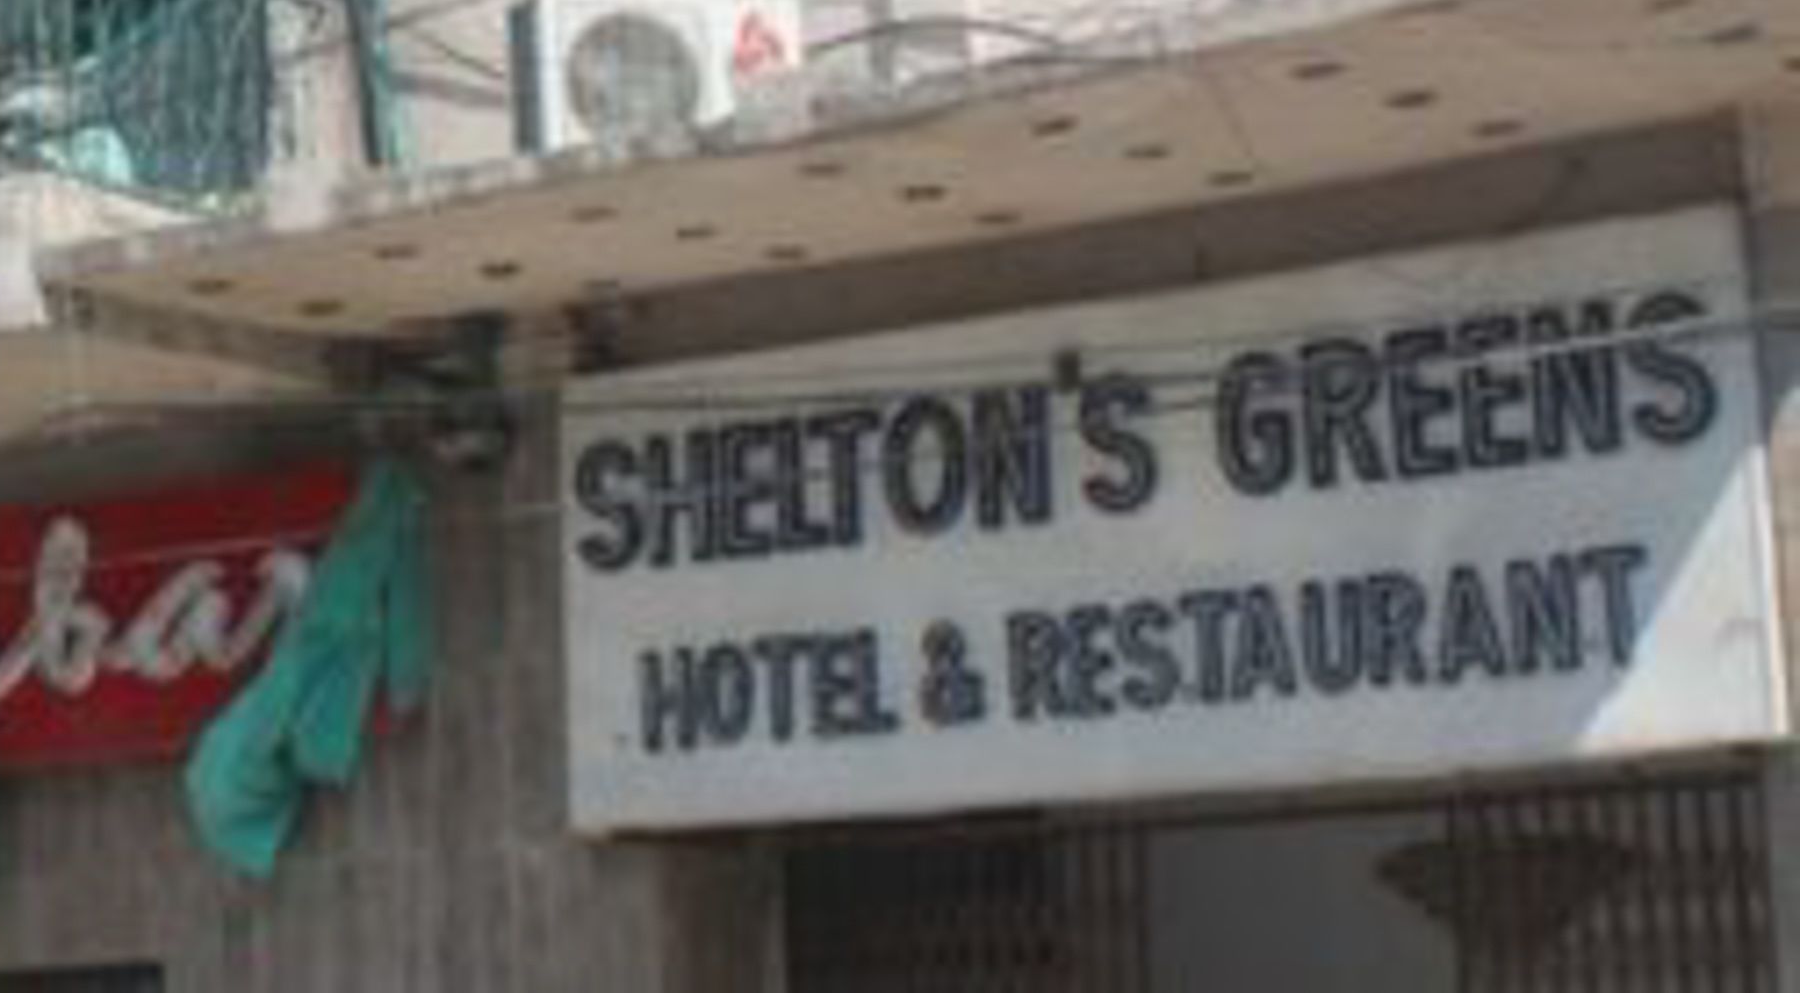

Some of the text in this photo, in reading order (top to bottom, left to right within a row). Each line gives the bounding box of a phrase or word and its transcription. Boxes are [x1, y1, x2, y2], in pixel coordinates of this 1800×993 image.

[574, 290, 1720, 572] SHELTON'S GREENS
[638, 542, 1650, 754] HOTEL & RESTAURANT
